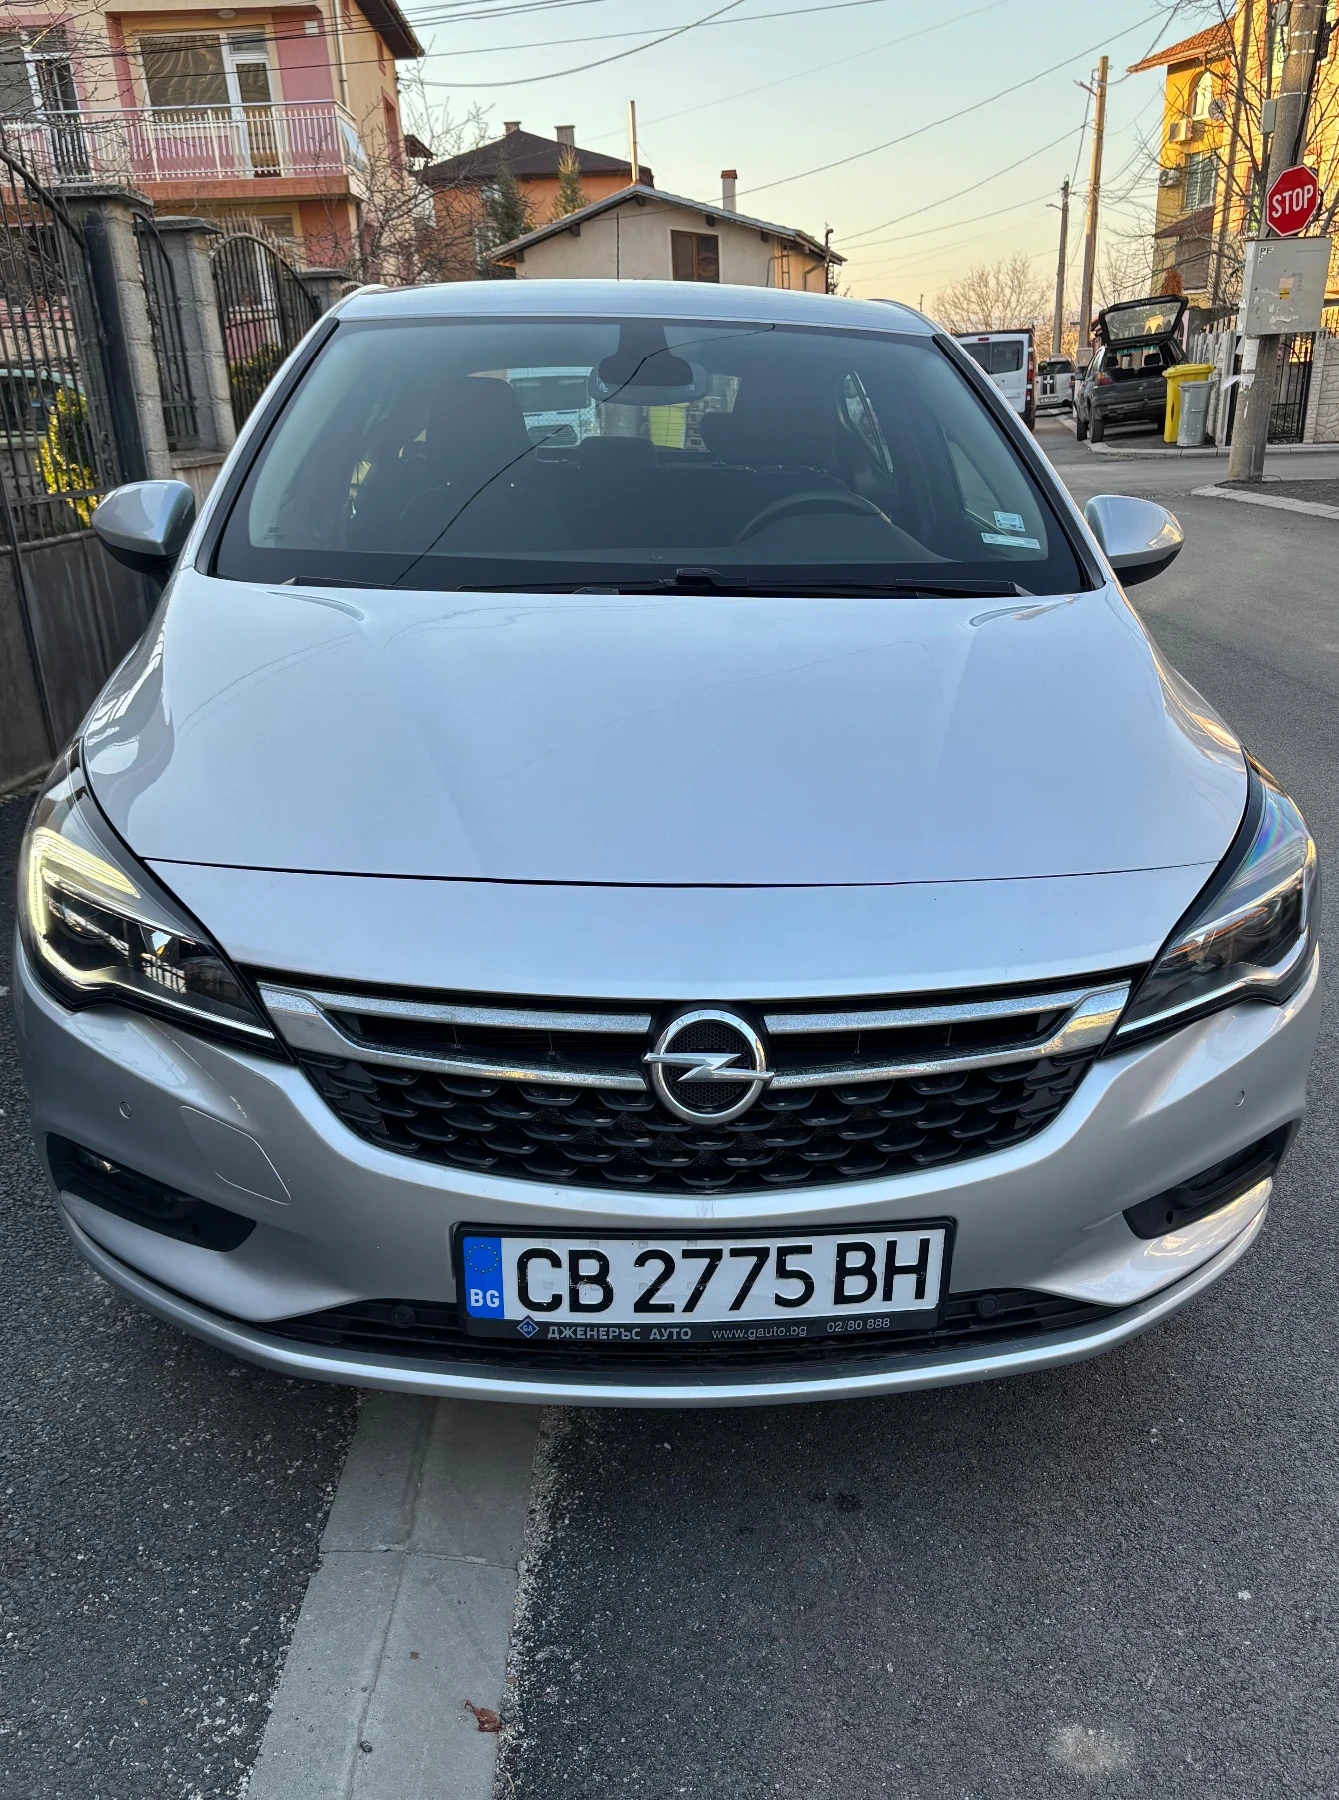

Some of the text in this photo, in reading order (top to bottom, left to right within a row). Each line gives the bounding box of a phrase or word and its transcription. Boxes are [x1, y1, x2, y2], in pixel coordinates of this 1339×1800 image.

[1272, 184, 1314, 219] STOP
[517, 1238, 930, 1313] CB 2775 BH
[470, 1288, 500, 1307] BG
[649, 1327, 692, 1340] АУТО
[711, 1326, 807, 1340] www.gauto.bg
[826, 1317, 891, 1333] 02/80 888
